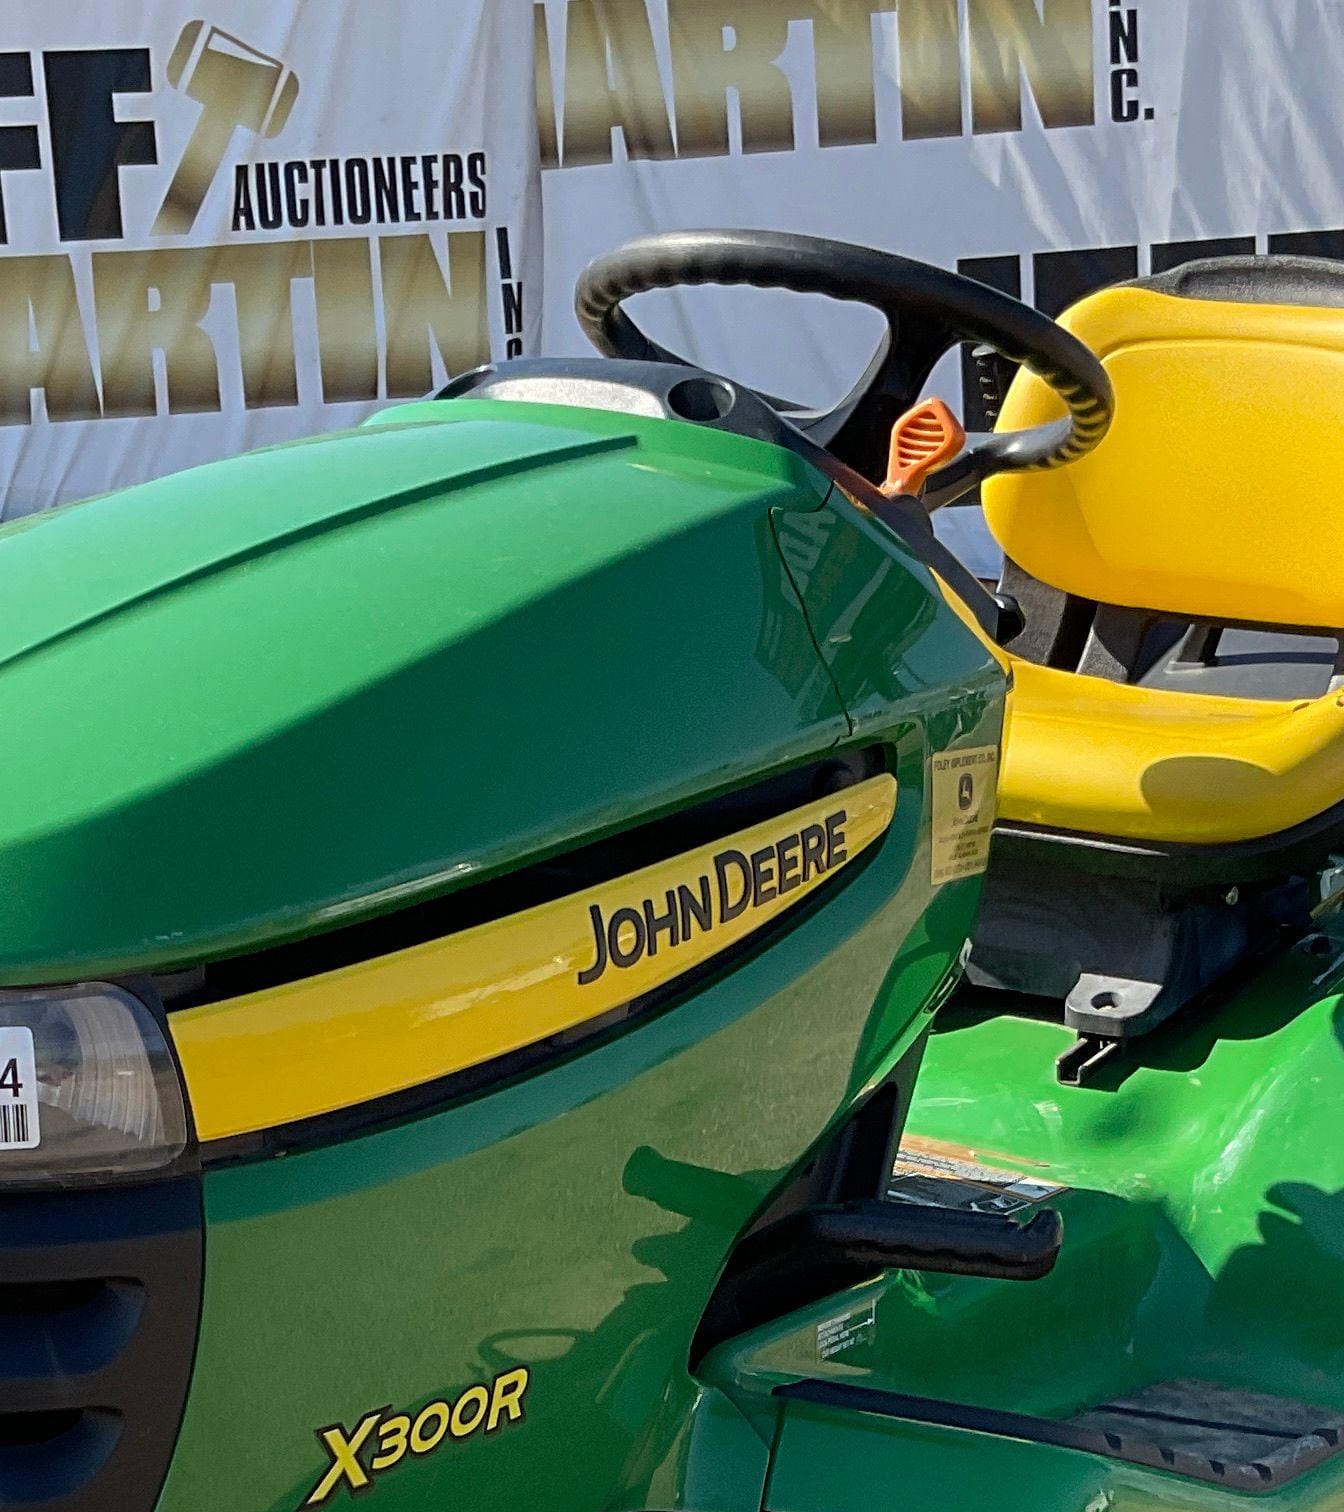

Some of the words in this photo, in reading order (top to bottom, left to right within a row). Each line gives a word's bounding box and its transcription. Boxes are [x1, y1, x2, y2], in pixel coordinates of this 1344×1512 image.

[534, 0, 1095, 169] ARTIN
[231, 152, 487, 232] AUCTIONEERS
[577, 875, 713, 985] JOHN
[712, 810, 848, 925] DEERE
[296, 1365, 530, 1512] X300R
